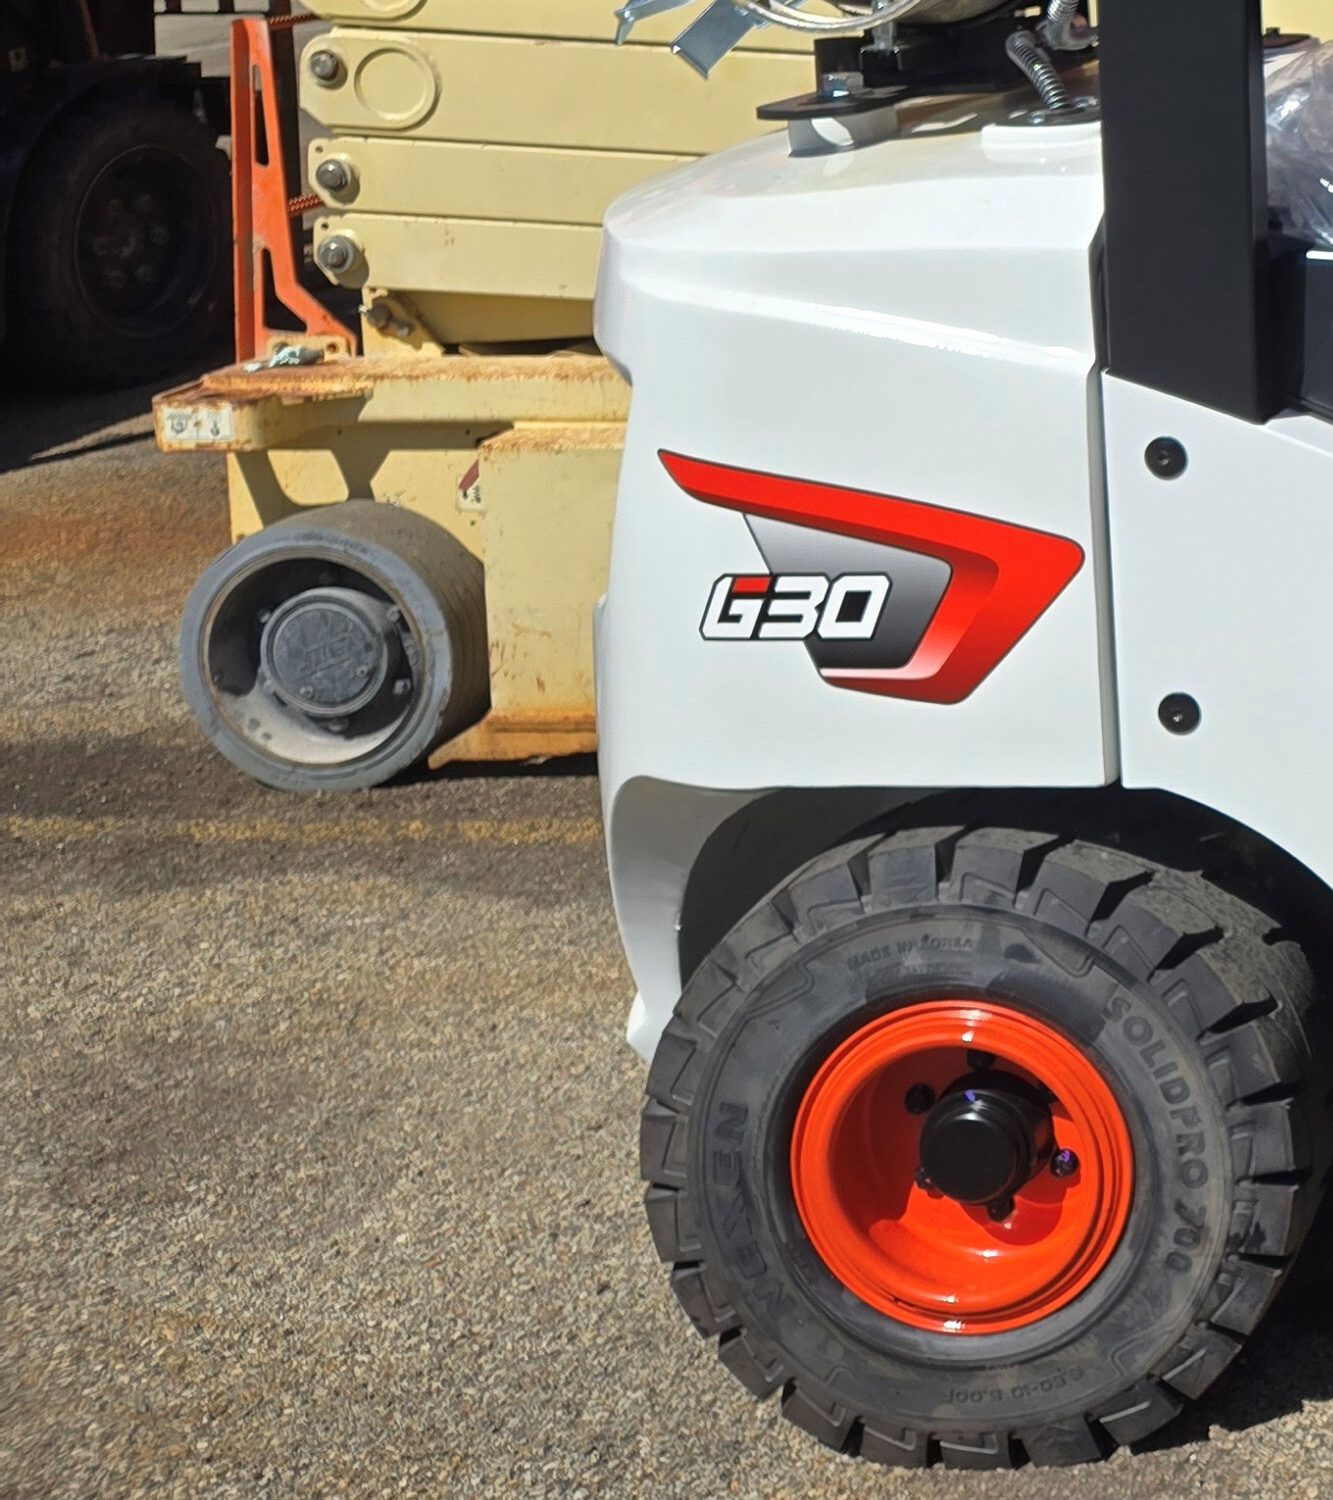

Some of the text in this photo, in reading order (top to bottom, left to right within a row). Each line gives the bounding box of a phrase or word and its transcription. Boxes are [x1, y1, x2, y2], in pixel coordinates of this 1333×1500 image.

[699, 573, 890, 640] G30
[712, 1101, 798, 1317] NEXEN
[1104, 996, 1209, 1273] SOLIDPRO 700
